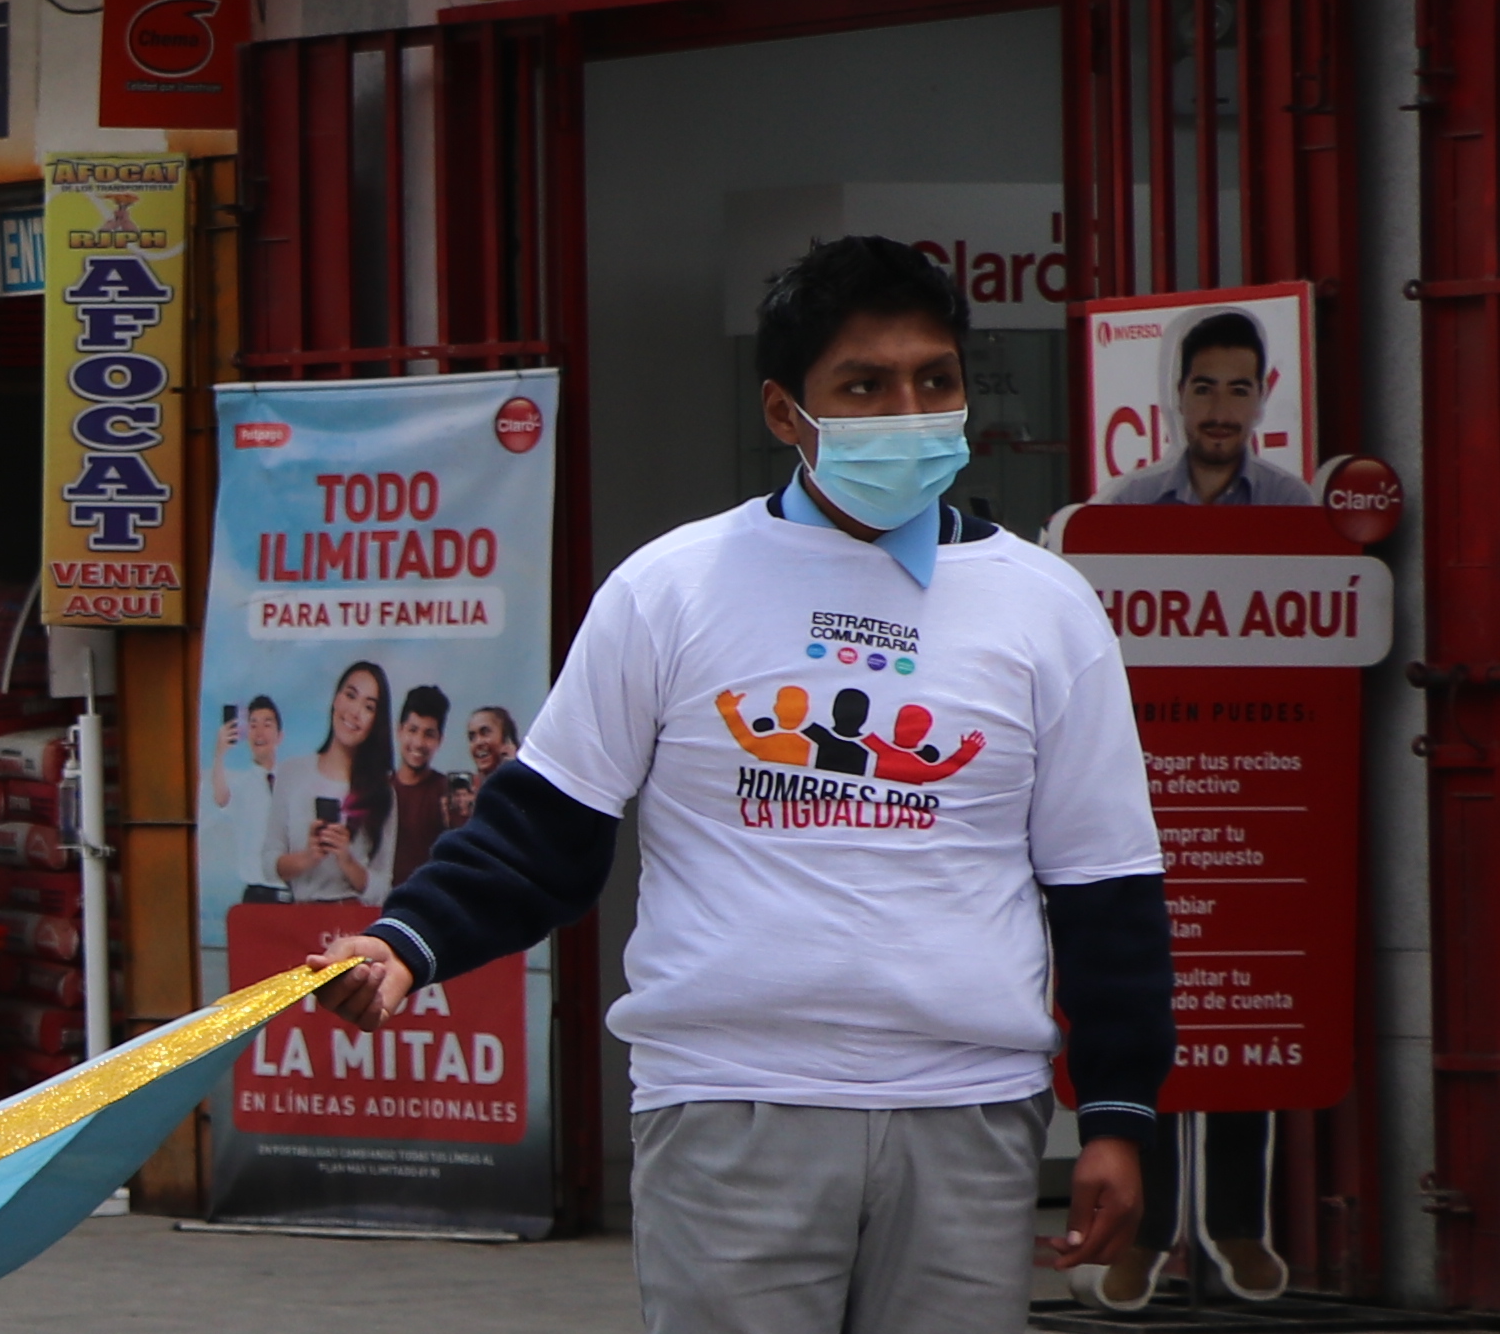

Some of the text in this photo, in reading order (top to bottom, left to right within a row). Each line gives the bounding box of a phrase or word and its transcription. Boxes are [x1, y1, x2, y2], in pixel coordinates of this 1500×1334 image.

[51, 157, 185, 184] AFOCAT
[62, 254, 173, 552] AFOCAT
[316, 470, 440, 524] TODO
[1328, 487, 1392, 511] Claro
[257, 527, 498, 582] ILIMITADO
[50, 561, 182, 590] VENTA
[62, 591, 165, 622] AQUÍ
[261, 599, 488, 628] PARA TU FAMILIA
[1240, 574, 1362, 641] AQUÍ
[809, 625, 920, 656] COMUNITARIA
[810, 610, 921, 642] ESTRATEGIA
[1212, 701, 1316, 723] PUEDES:
[1142, 752, 1301, 775] Pagar tus recibos
[735, 764, 878, 805] HOMBRES
[1166, 775, 1240, 795] efectivo
[739, 797, 938, 831] LA IGUALDAD
[1225, 825, 1246, 843] tu
[1179, 849, 1264, 871] repuesto
[1231, 968, 1252, 988] tu
[1202, 991, 1293, 1011] de cuenta
[330, 1028, 506, 1086] MITAD
[1242, 1036, 1304, 1068] MÁS
[240, 1087, 518, 1124] EN LÍNEAS ADICIONALES
